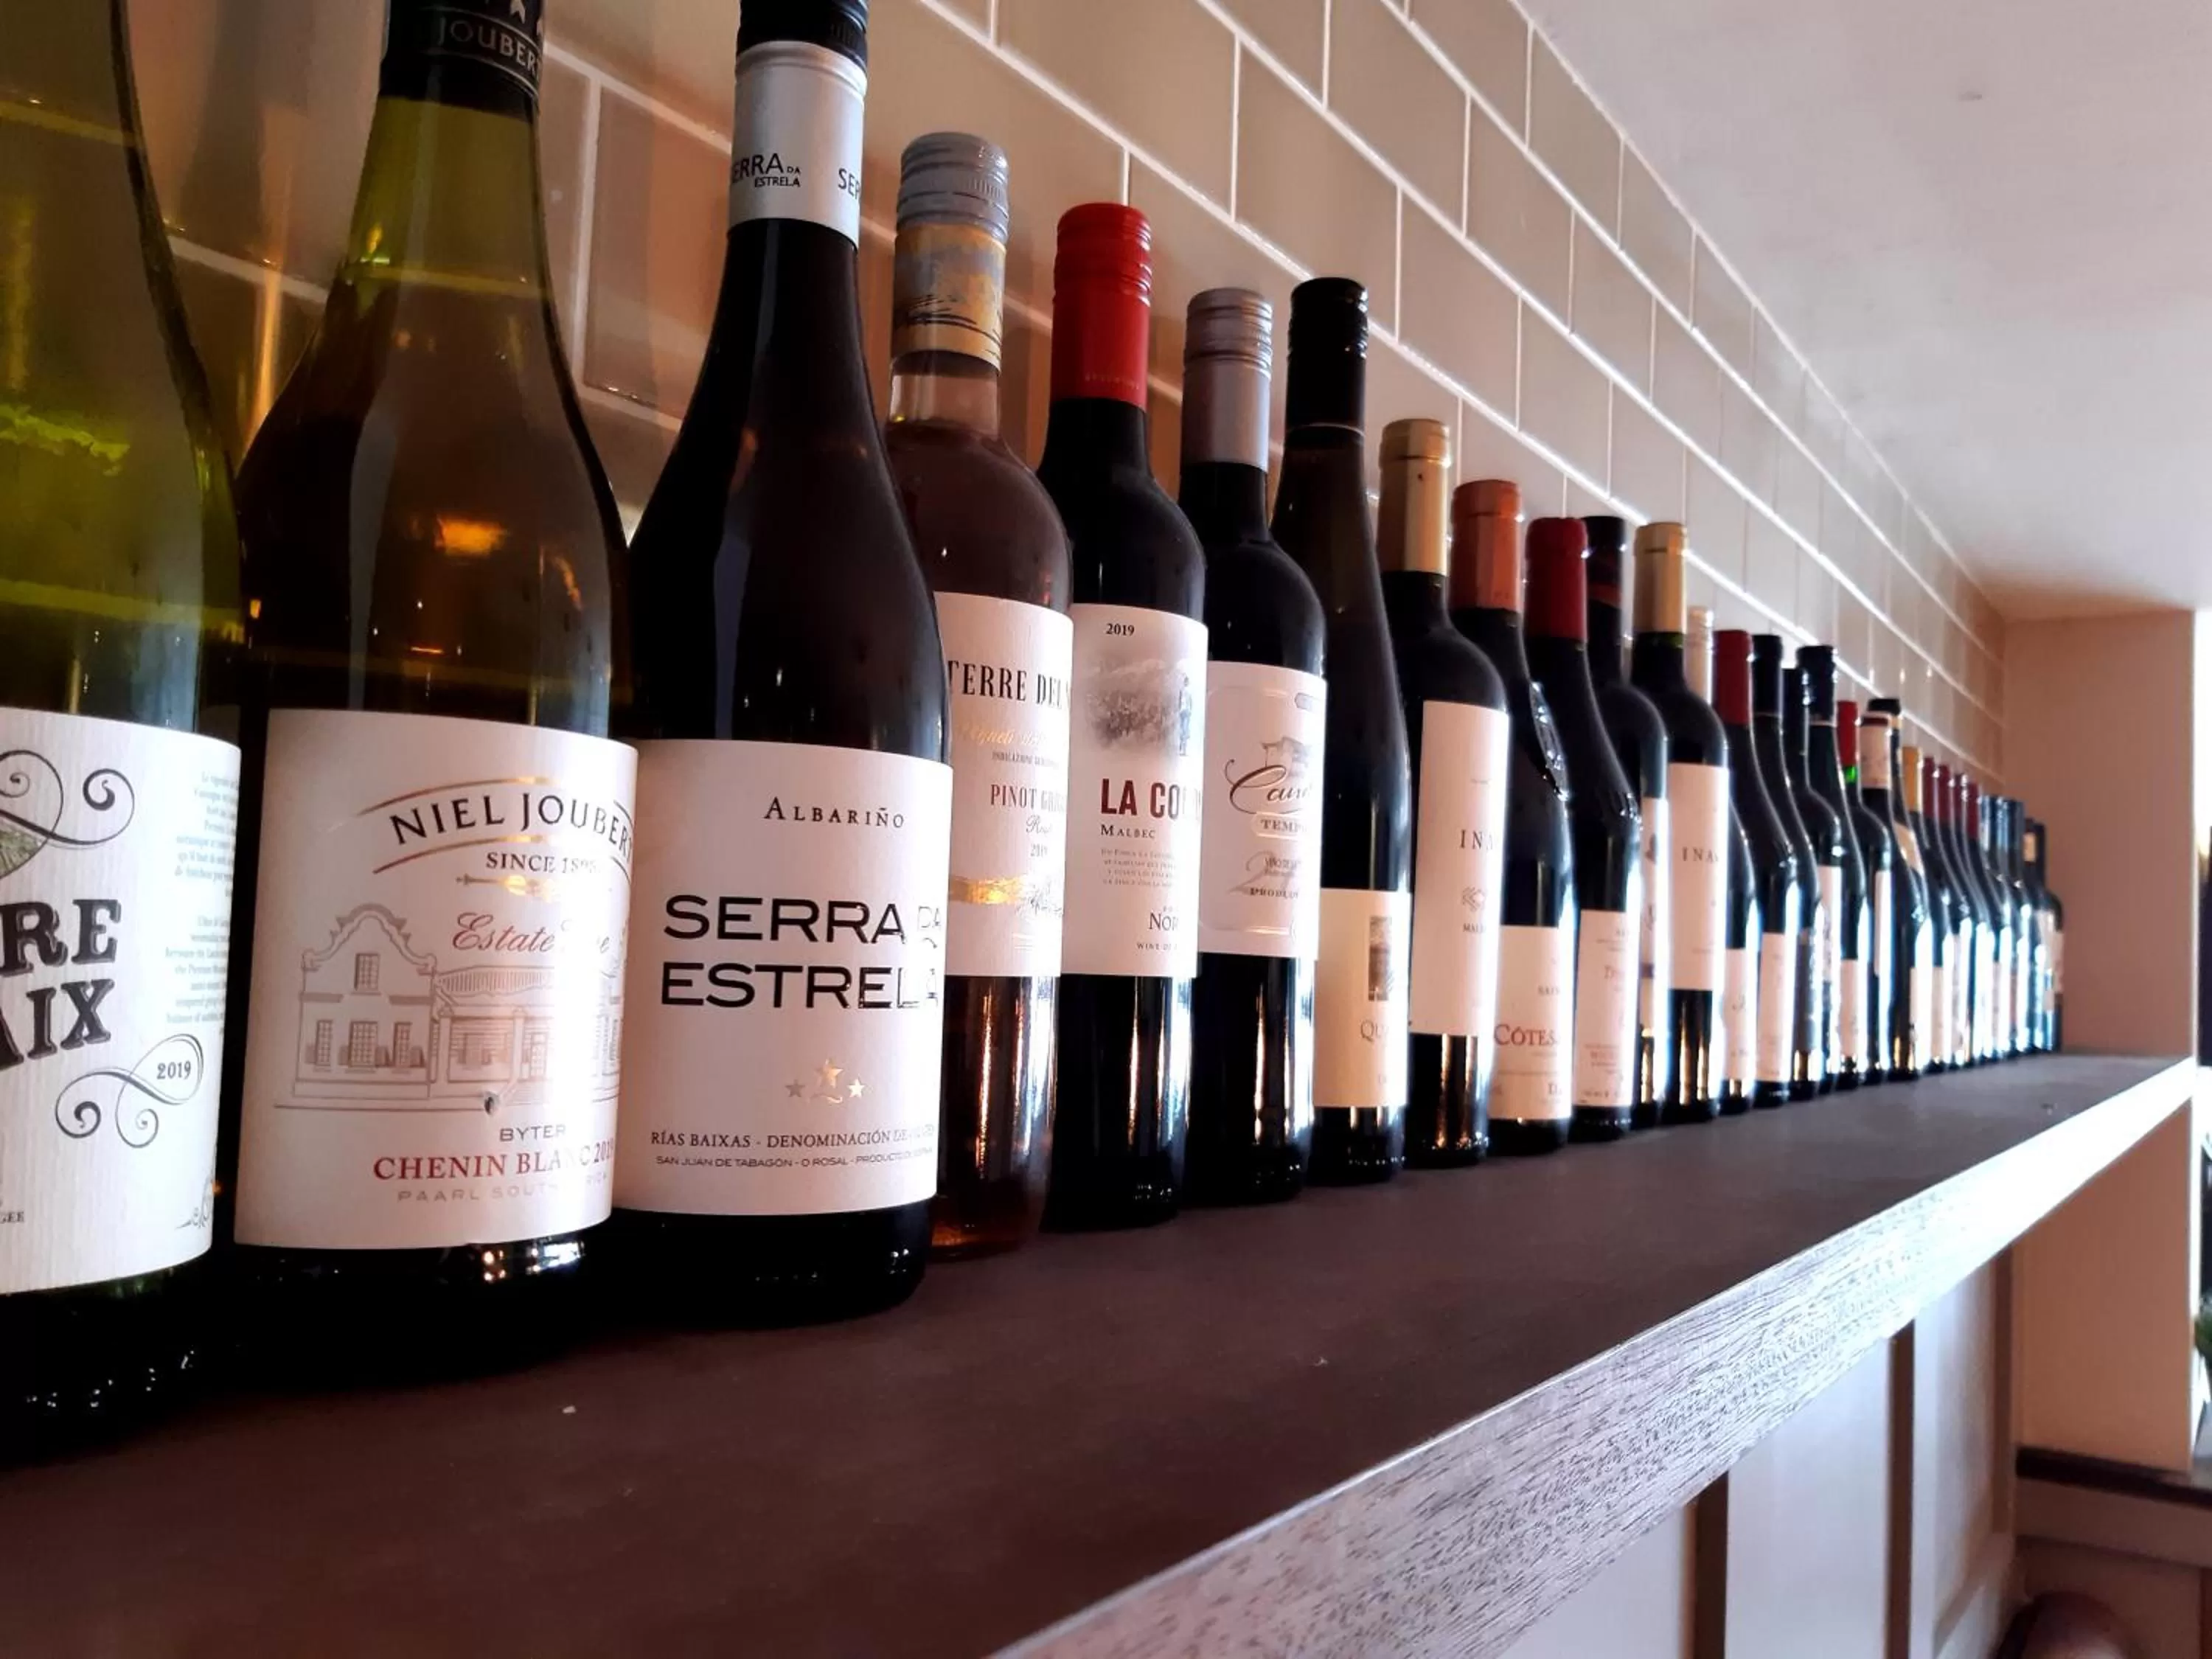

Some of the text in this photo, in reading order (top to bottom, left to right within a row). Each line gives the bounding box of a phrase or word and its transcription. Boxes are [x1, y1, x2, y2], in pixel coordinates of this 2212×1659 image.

[787, 166, 801, 174] DA
[754, 176, 801, 188] ESTRELA
[1105, 623, 1135, 636] 2019
[990, 784, 1037, 810] PINOT
[1101, 779, 1138, 815] LA
[390, 795, 504, 845] NIEL
[486, 852, 556, 873] SINCE
[664, 894, 905, 945] SERRA
[453, 912, 556, 953] Estate
[156, 1061, 192, 1079] 2019
[689, 1133, 751, 1148] BAIXAS
[767, 1128, 890, 1148] DENOMINACIÓN
[374, 1153, 506, 1180] CHENIN
[656, 1155, 679, 1166] SAN
[681, 1157, 713, 1166] JUAN
[715, 1158, 731, 1167] DE
[813, 1158, 849, 1167] ROSAL
[397, 1184, 481, 1202] PAARL
